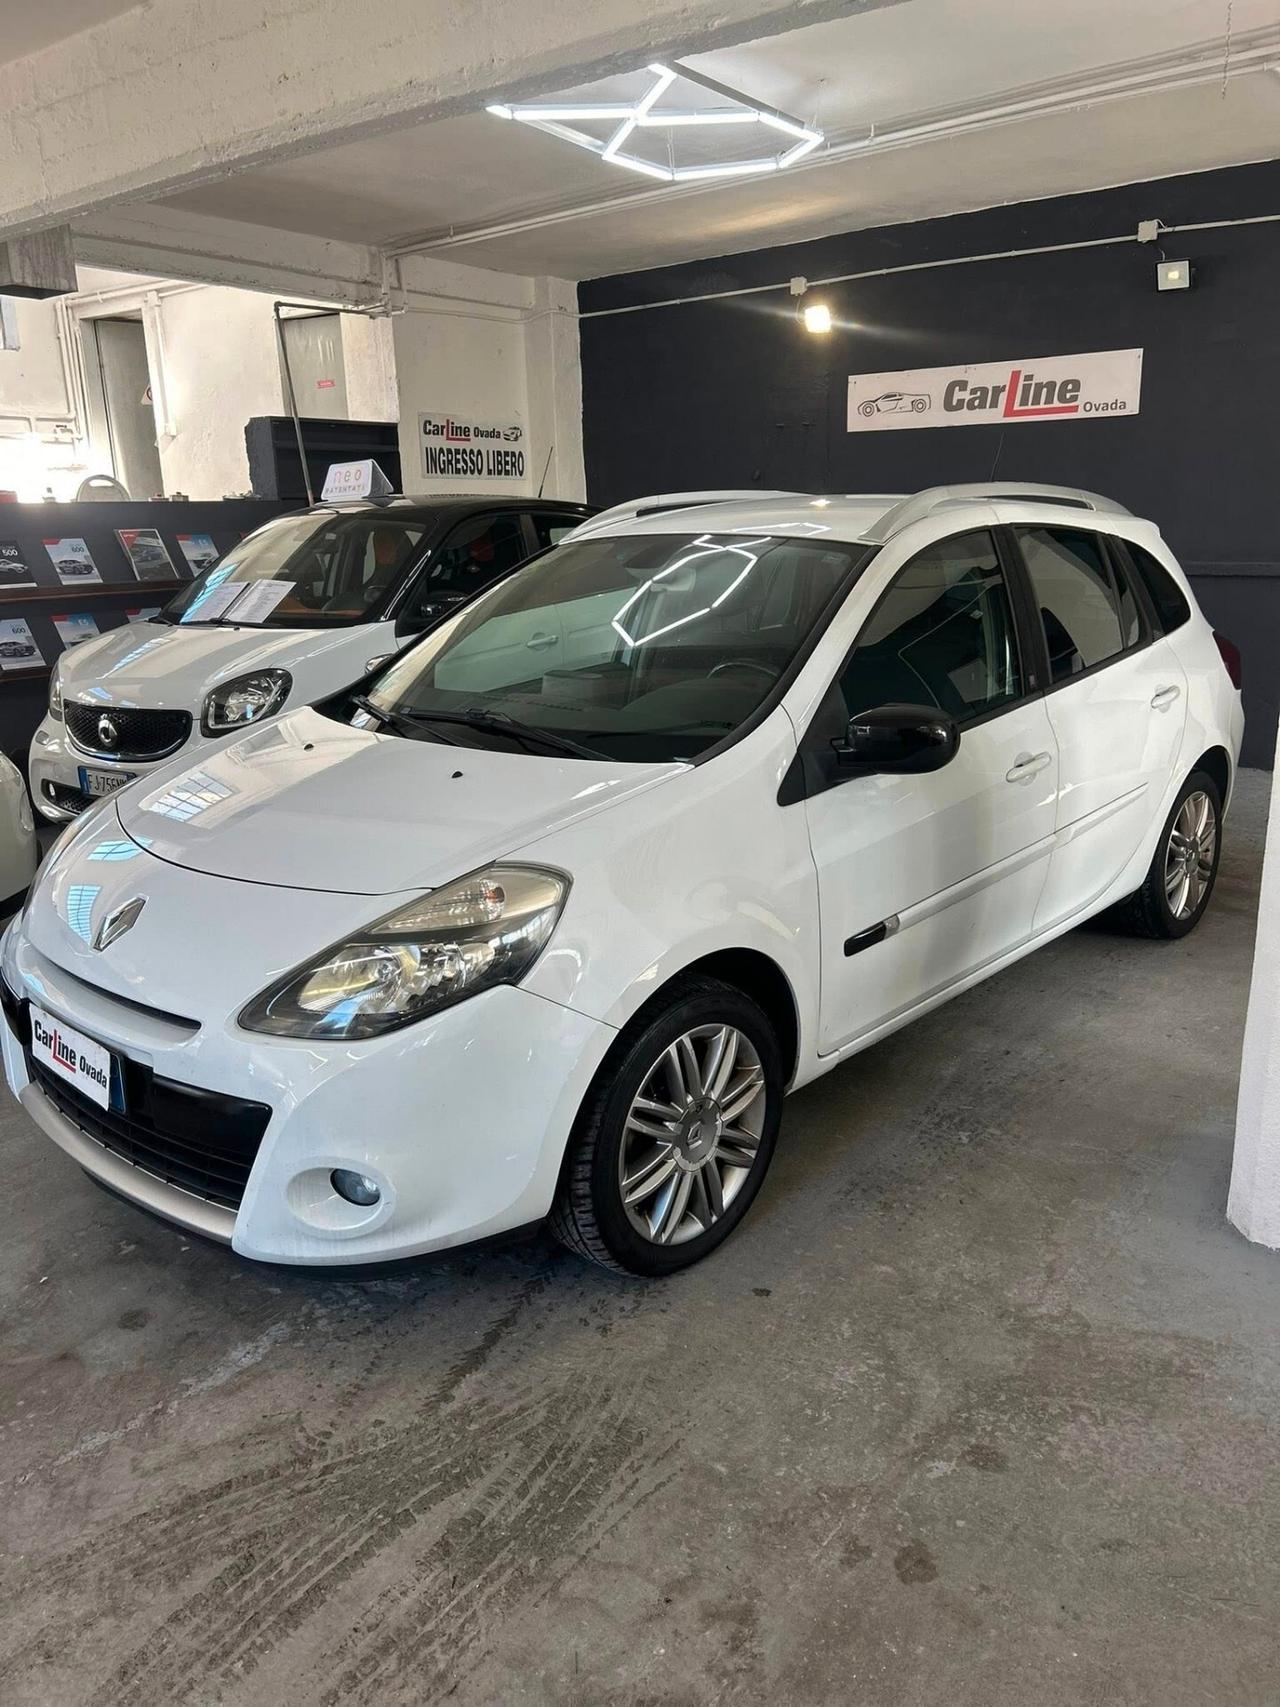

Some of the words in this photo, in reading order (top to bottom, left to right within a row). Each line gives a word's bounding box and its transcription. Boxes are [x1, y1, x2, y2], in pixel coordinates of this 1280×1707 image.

[943, 370, 1082, 418] CarLine
[1083, 399, 1127, 413] Ovada
[423, 418, 471, 442] CarLine
[473, 426, 501, 439] Ovada
[334, 469, 362, 484] neo
[425, 447, 484, 476] INGRESSO
[486, 449, 525, 477] LIBERO
[34, 1019, 77, 1074] CarLine
[79, 1055, 108, 1090] Ovada
